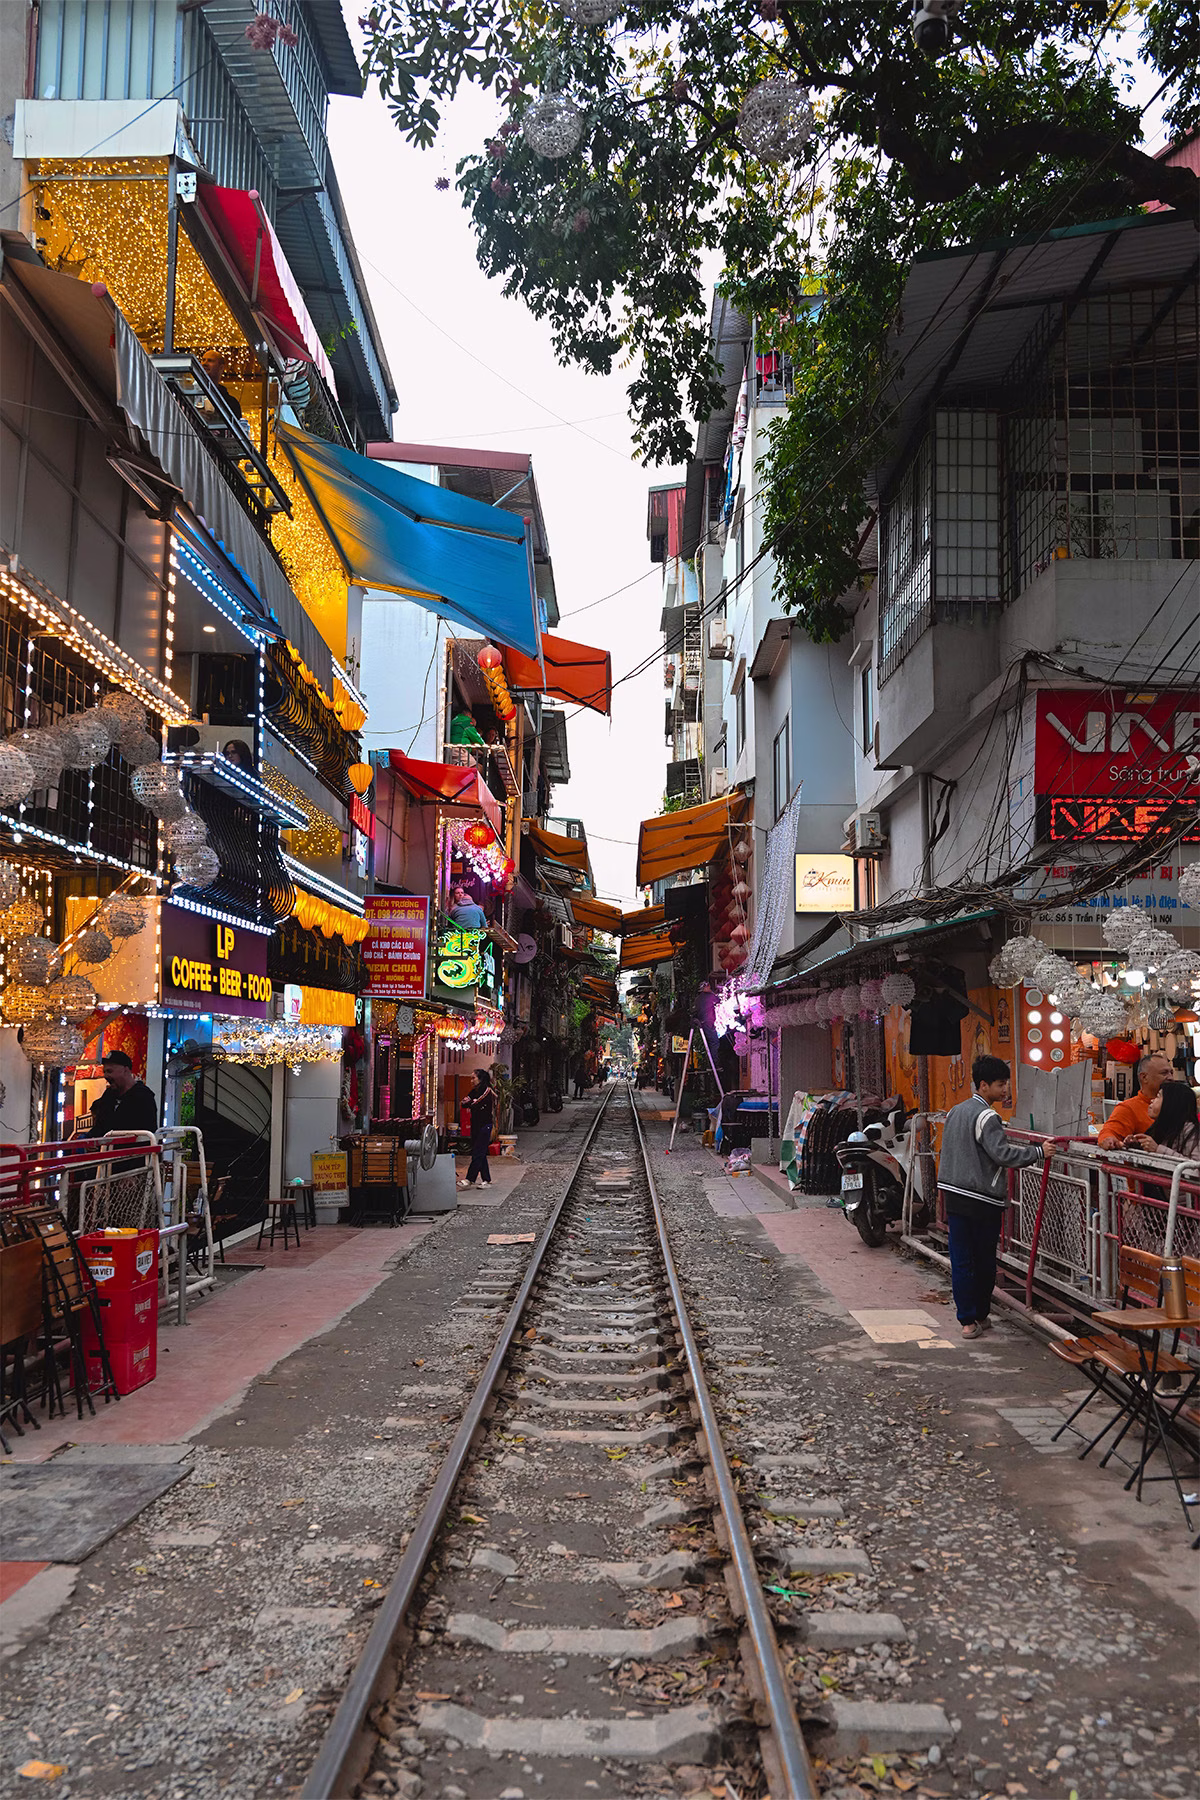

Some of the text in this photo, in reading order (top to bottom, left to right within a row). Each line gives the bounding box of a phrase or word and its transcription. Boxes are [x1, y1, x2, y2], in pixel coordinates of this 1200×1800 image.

[1096, 914, 1107, 923] Ph
[217, 923, 235, 960] LP
[171, 955, 212, 992] COFFEE
[219, 967, 242, 998] BEER
[248, 973, 272, 1002] FOOD
[391, 963, 417, 973] CHUA
